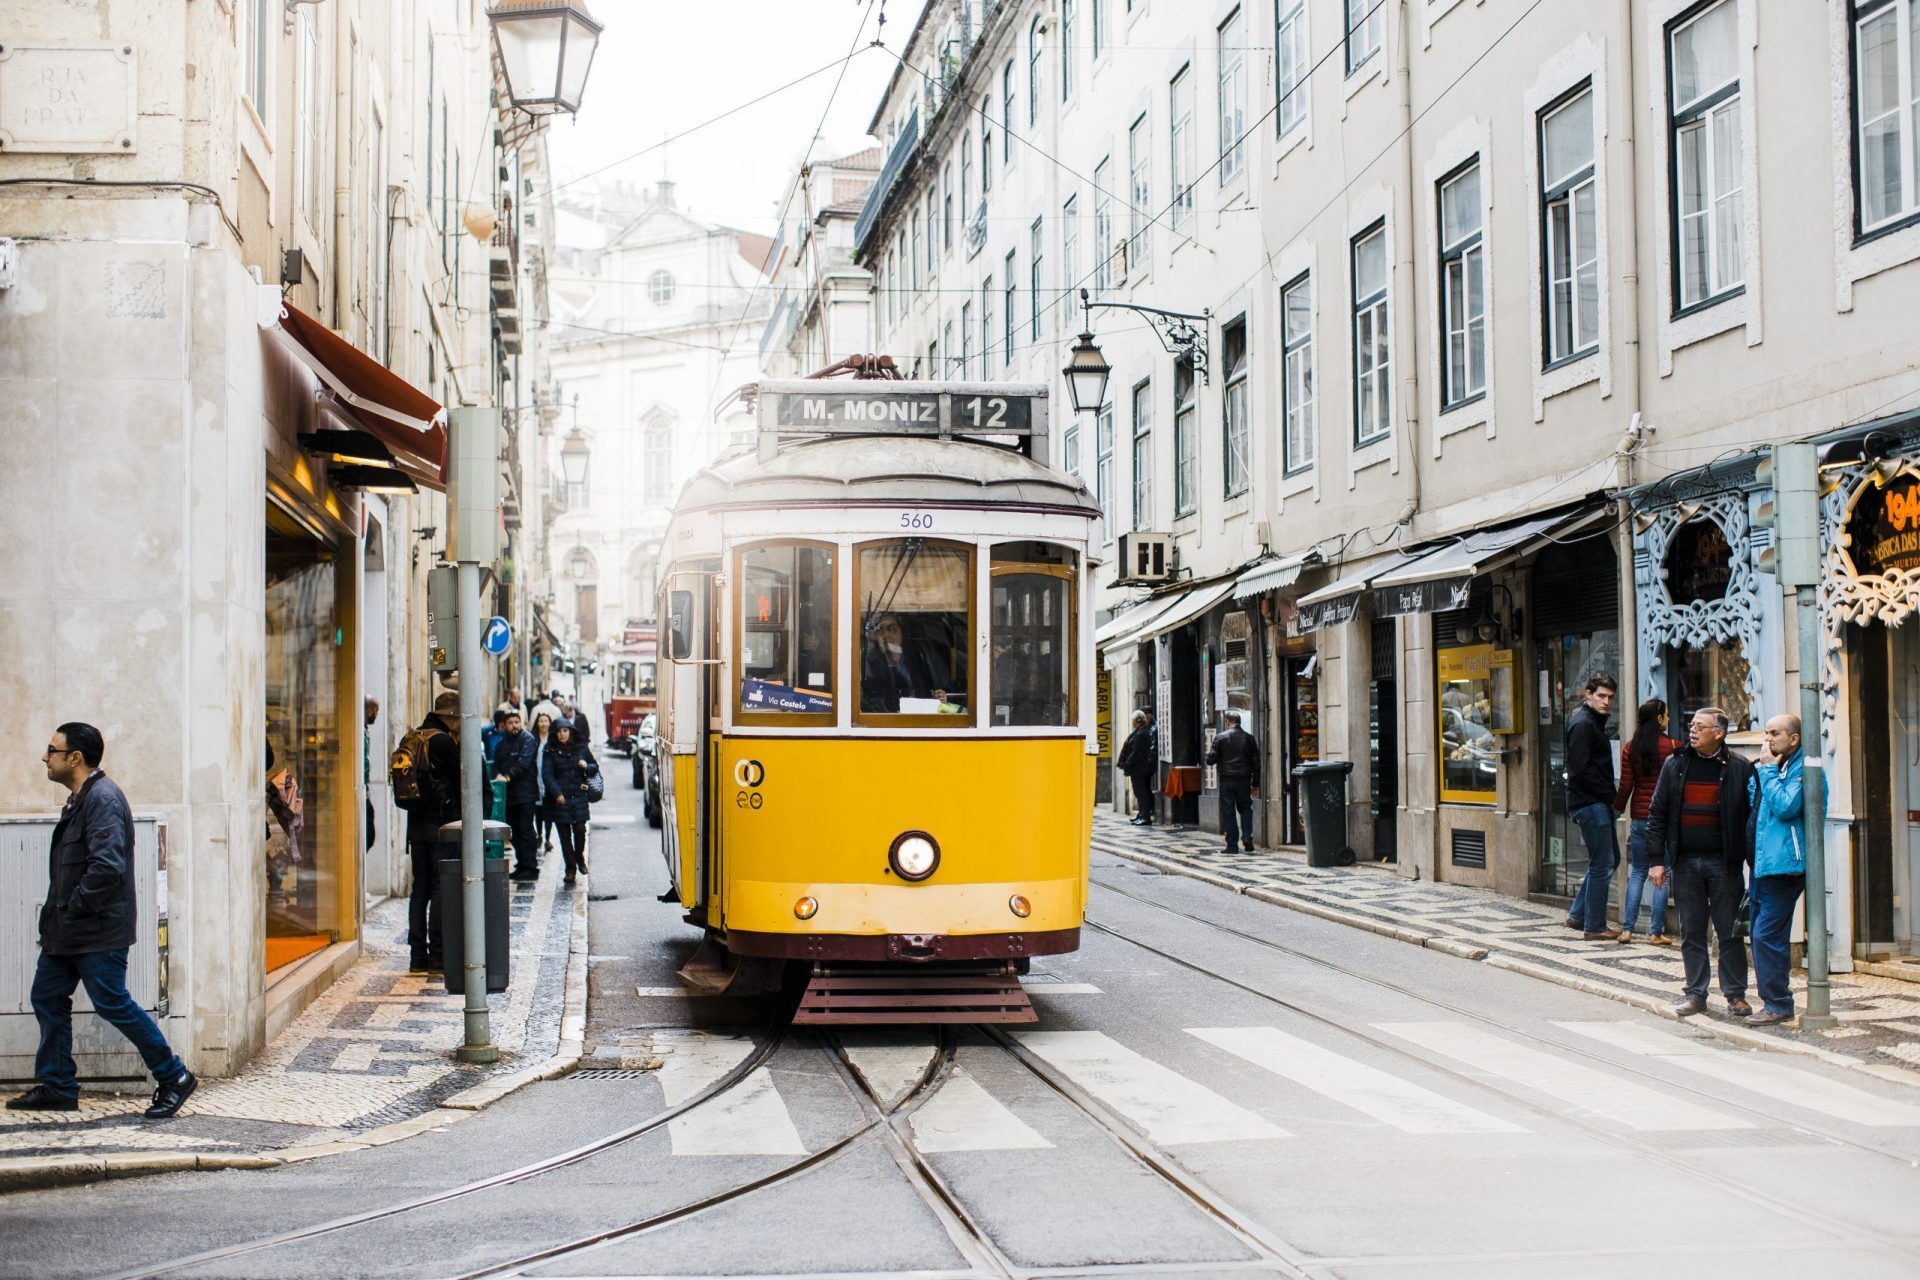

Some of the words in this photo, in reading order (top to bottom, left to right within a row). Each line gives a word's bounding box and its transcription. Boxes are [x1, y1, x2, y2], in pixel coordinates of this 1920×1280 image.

[49, 90, 80, 104] DA
[803, 399, 835, 421] M.
[844, 399, 938, 423] MONIZ
[966, 397, 1008, 428] 12
[900, 513, 934, 529] 560
[1902, 530, 1917, 551] DAS
[768, 696, 778, 705] Via
[780, 698, 807, 710] Castelo
